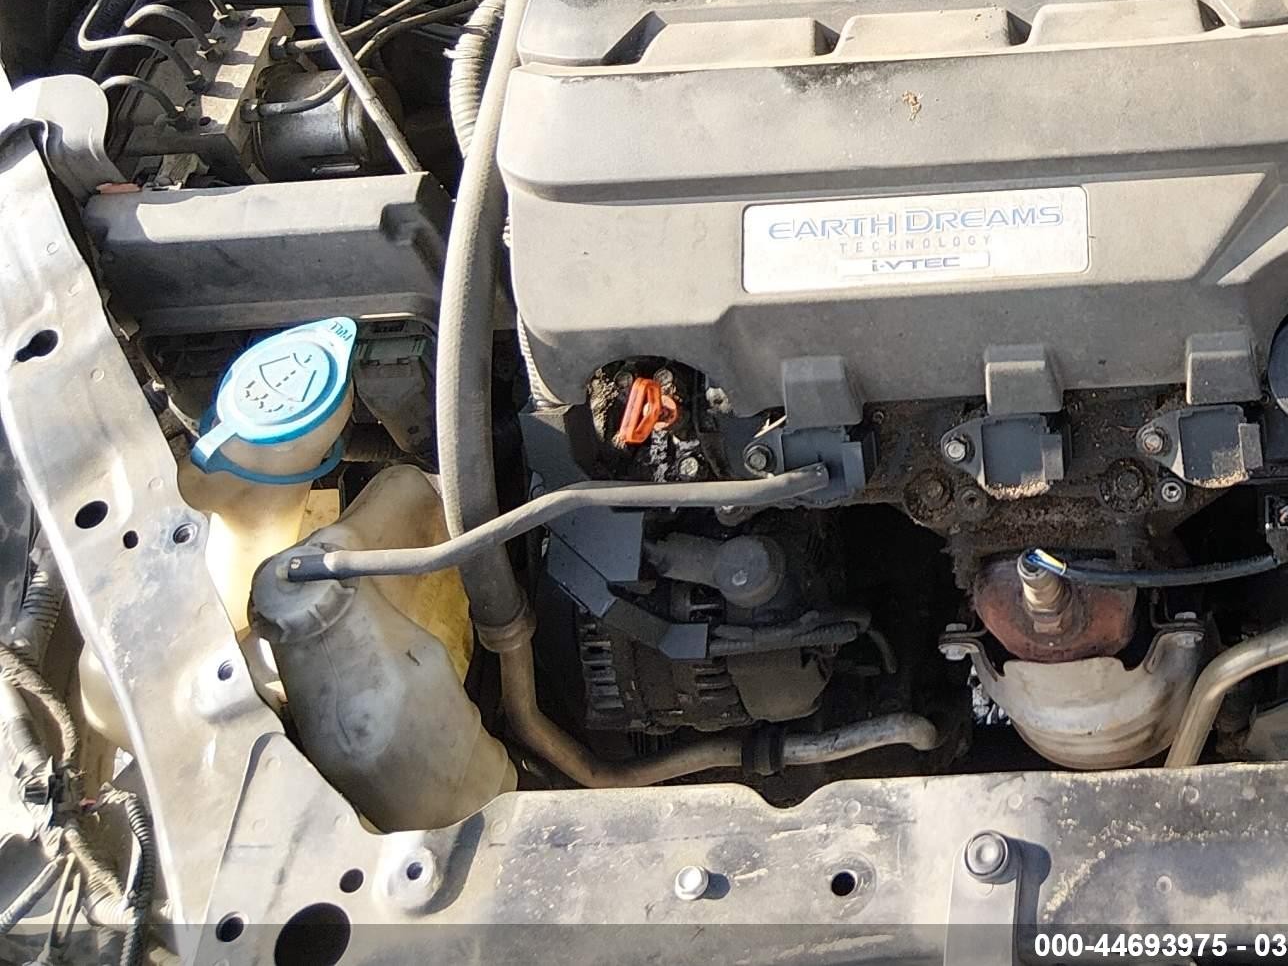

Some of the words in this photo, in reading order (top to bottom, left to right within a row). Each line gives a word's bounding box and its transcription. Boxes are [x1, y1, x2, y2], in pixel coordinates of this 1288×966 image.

[768, 213, 896, 240] EARTH
[839, 234, 993, 253] TECHNOLOGY
[872, 255, 961, 272] i-VTEC
